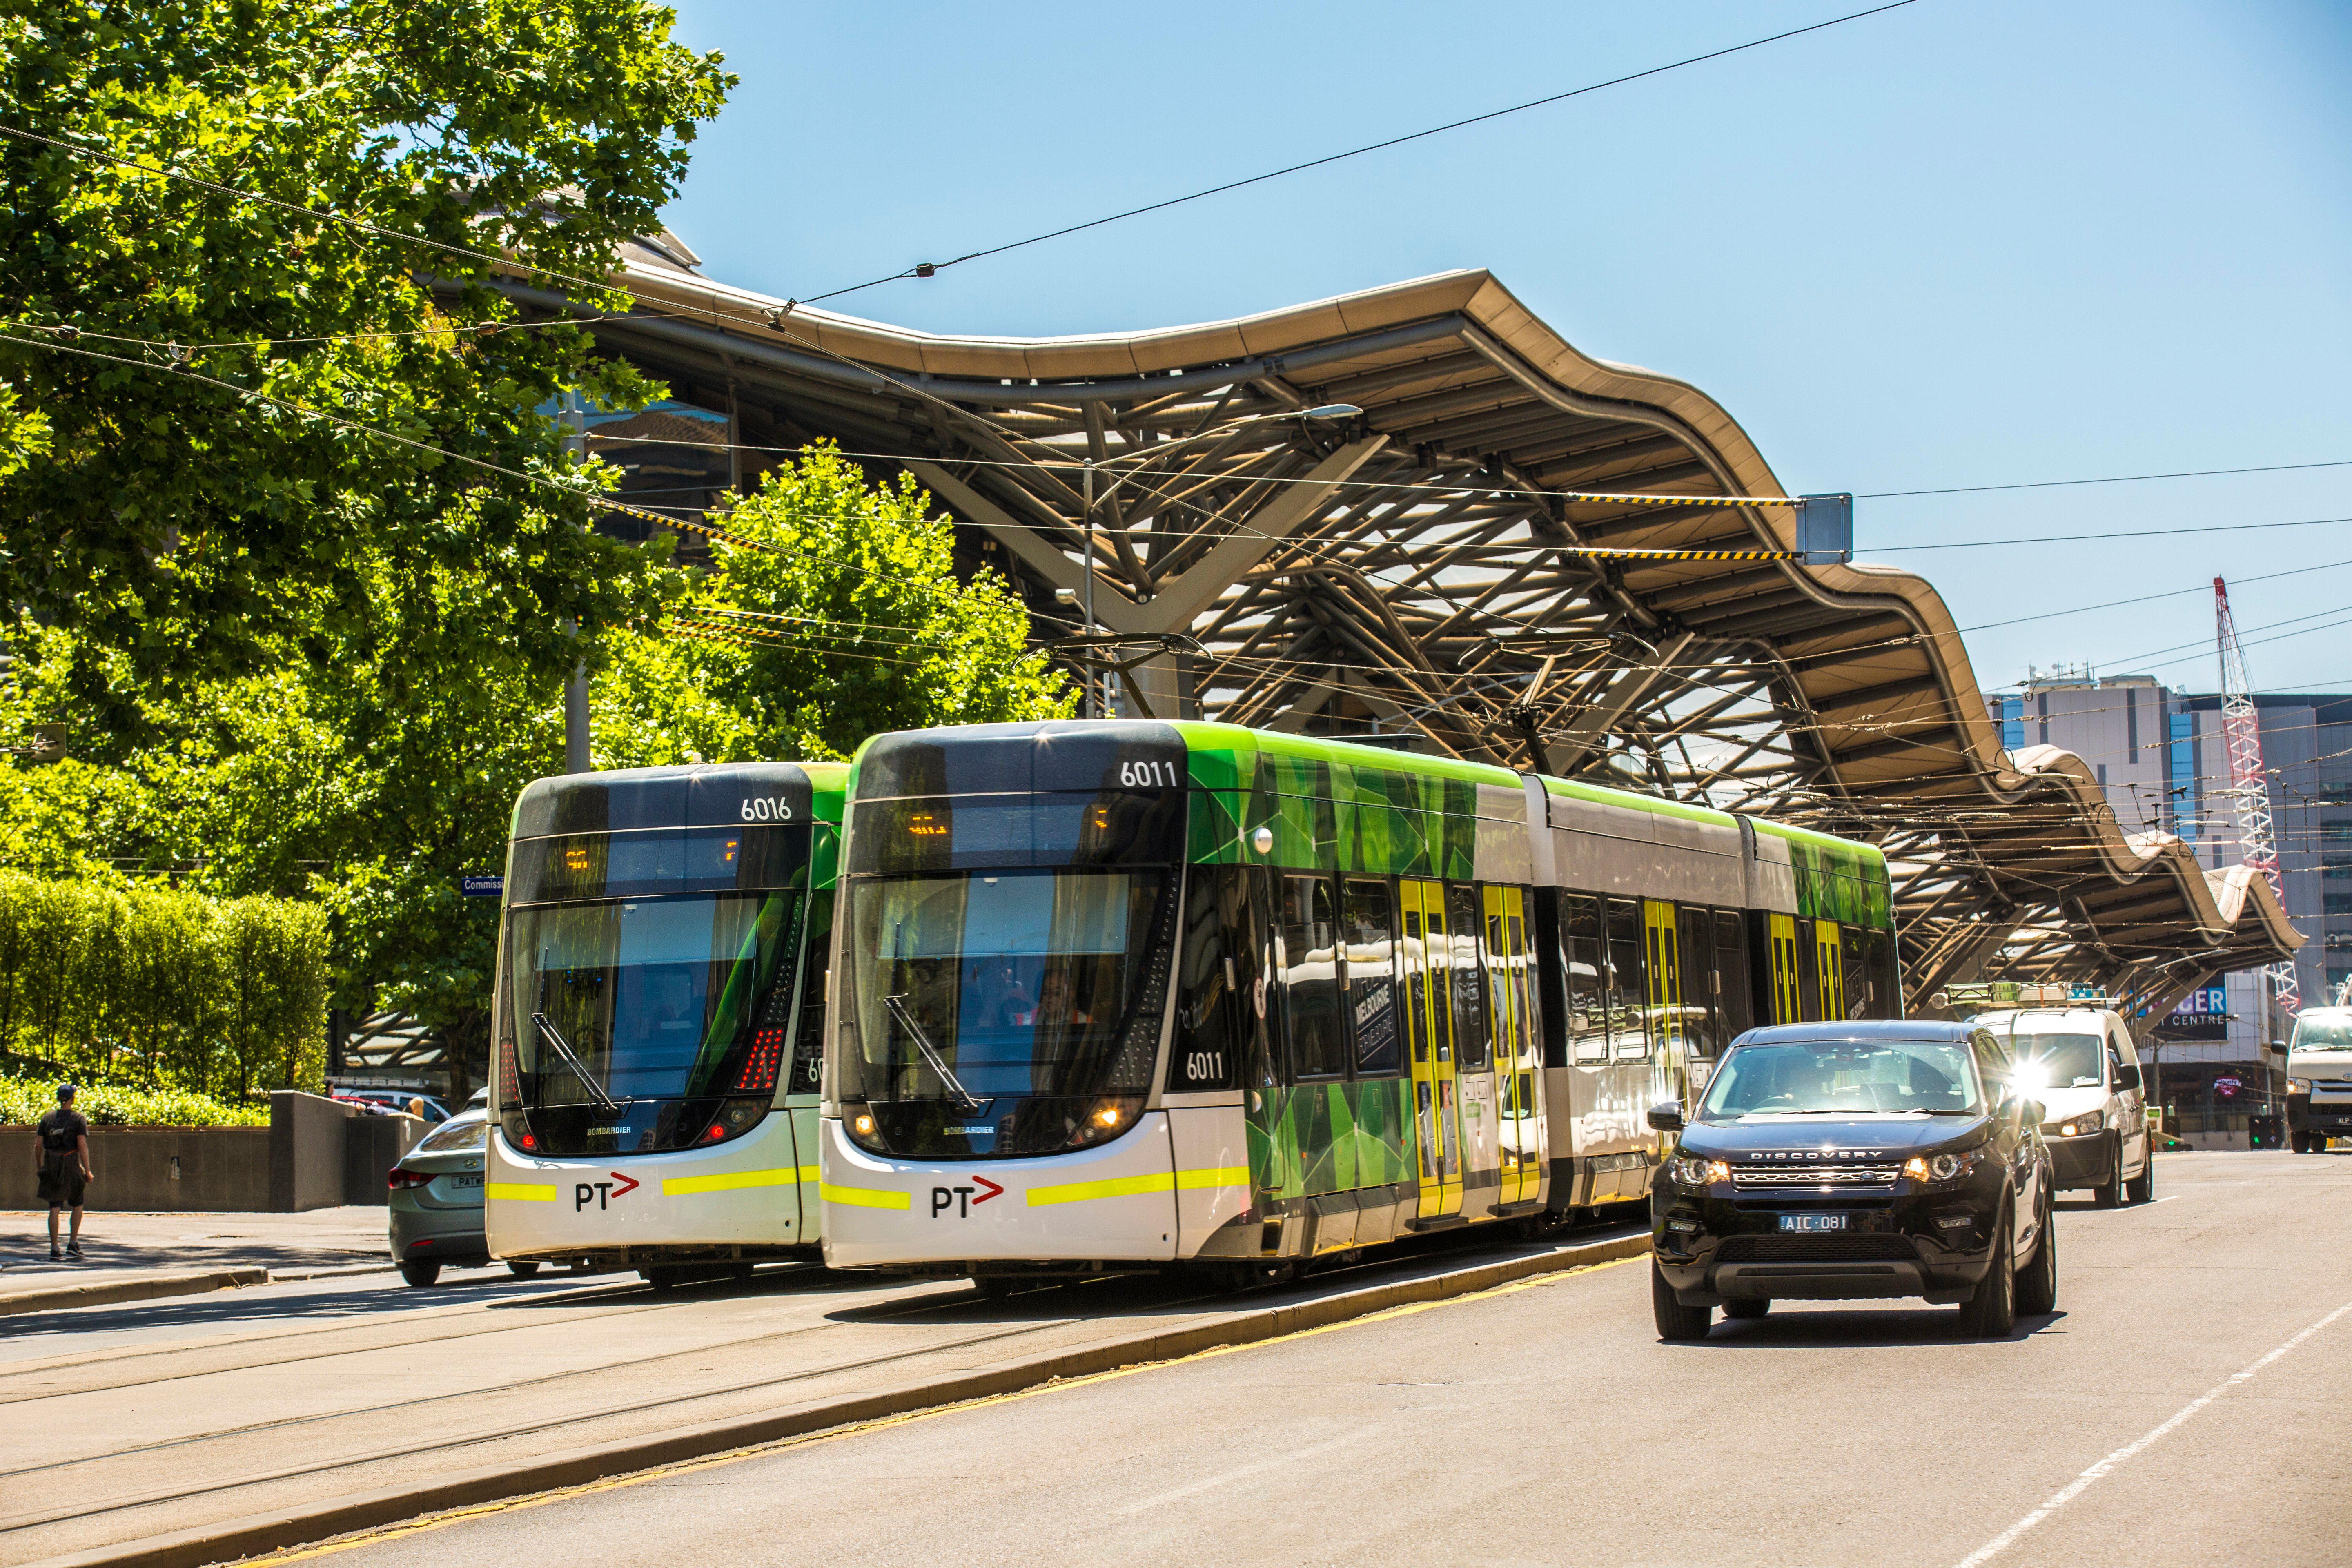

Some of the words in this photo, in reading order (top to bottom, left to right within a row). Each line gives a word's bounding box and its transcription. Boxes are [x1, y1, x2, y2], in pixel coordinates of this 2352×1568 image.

[1120, 761, 1177, 787] 6011
[741, 797, 792, 821] 6016
[2172, 1015, 2224, 1026] CENTRE
[1186, 1052, 1223, 1080] 6011
[587, 1127, 631, 1136] BOMBARDIER
[1751, 1151, 1882, 1160] DISCOVERY
